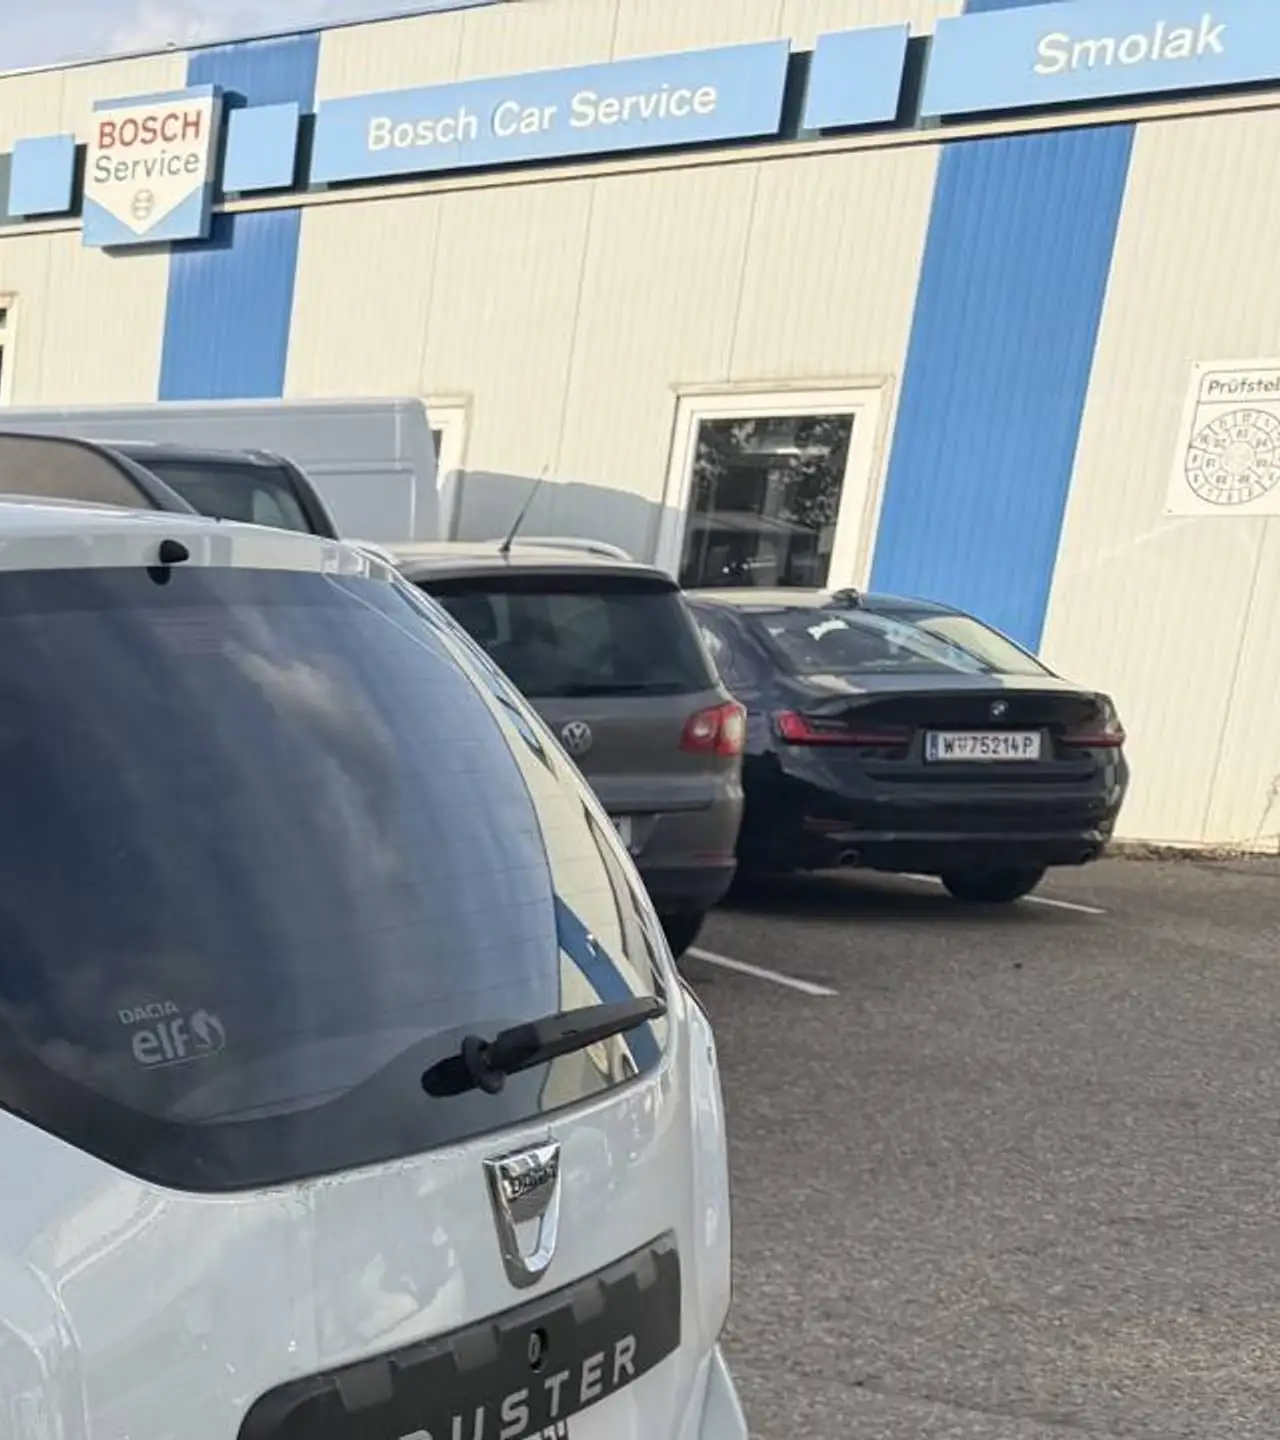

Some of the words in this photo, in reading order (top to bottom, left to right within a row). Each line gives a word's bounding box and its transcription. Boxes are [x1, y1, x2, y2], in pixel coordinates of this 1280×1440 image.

[1033, 14, 1228, 75] Smolak
[97, 110, 202, 149] BOSCH
[368, 106, 478, 152] Bosch
[492, 99, 556, 138] Car
[568, 84, 718, 128] Service
[93, 148, 200, 184] Service
[132, 1018, 190, 1064] elf
